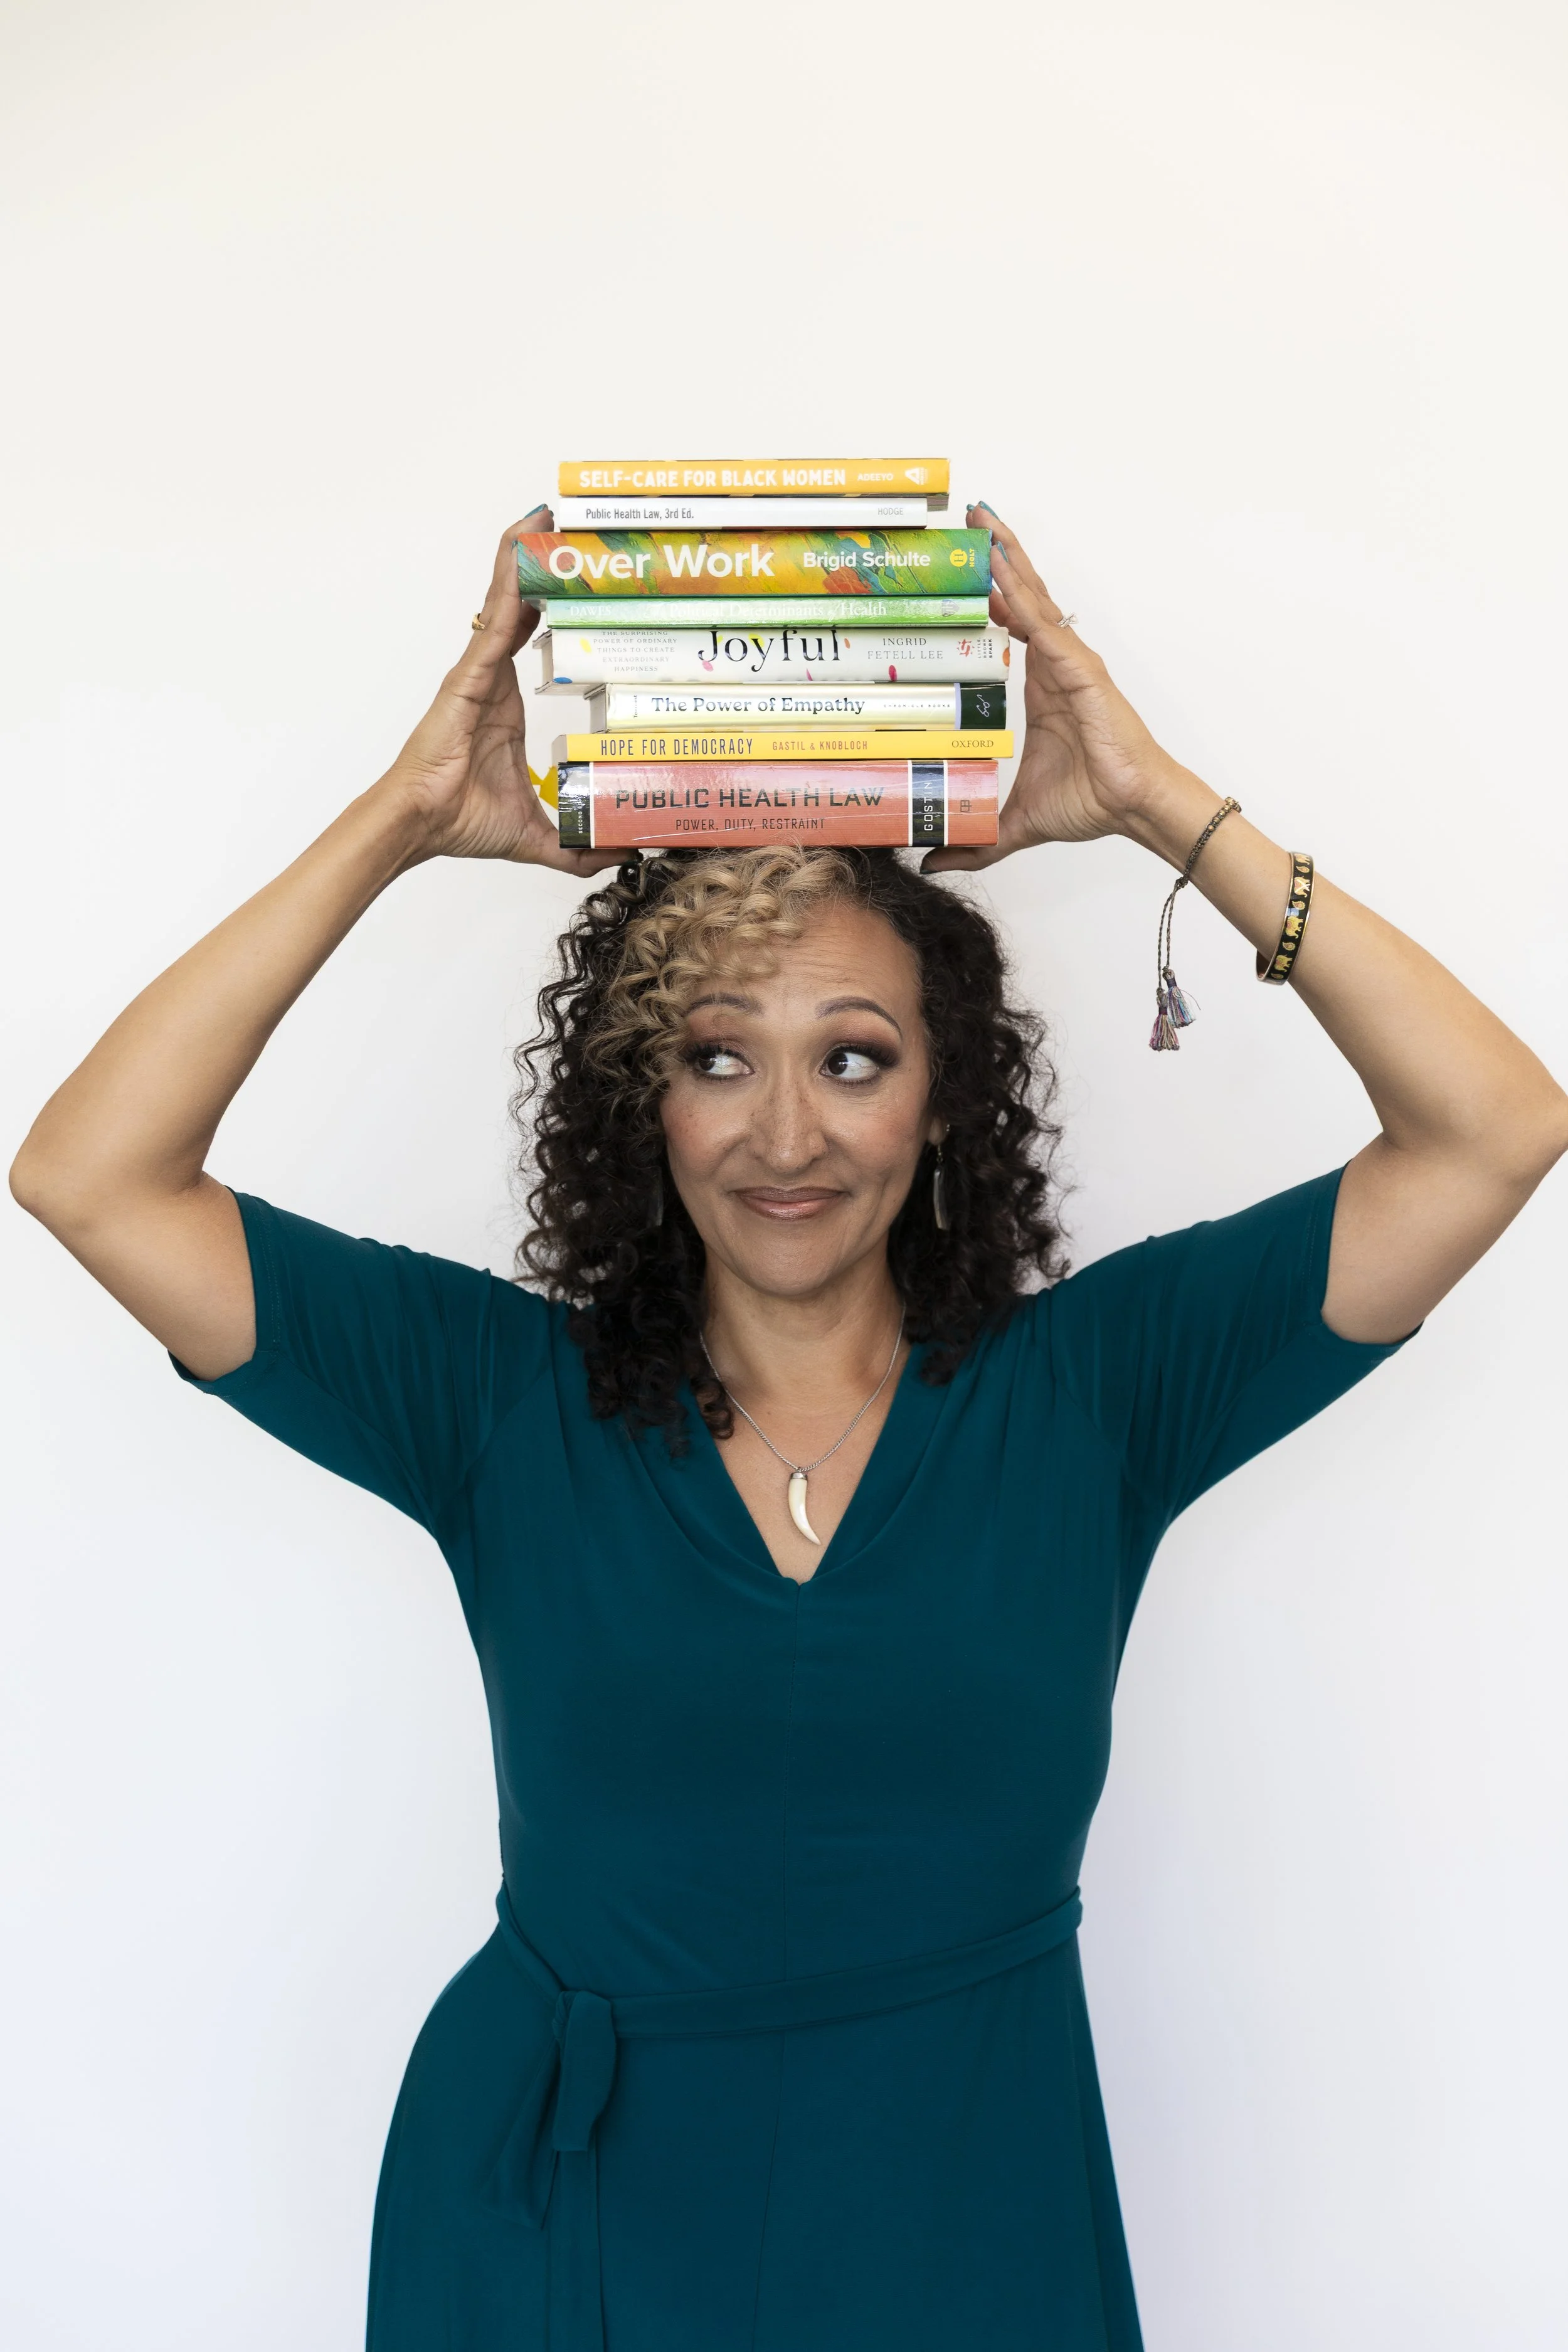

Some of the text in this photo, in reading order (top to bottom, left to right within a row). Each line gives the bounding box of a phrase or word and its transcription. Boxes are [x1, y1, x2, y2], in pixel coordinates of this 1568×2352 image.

[580, 469, 846, 487] SELF-CARE FOR BLACK WOMEN
[857, 472, 894, 482] ADEEYO
[586, 508, 694, 521] Public Health Law, 3rd Ed.
[878, 507, 904, 516] HODGE
[549, 544, 775, 580] Over Work
[803, 551, 931, 571] Brigid Schulte
[569, 605, 612, 617] DAWES
[840, 600, 887, 616] Health
[882, 638, 927, 646] INGRID
[697, 629, 841, 672] Joyful
[867, 650, 943, 659] FETELL LEE
[651, 697, 865, 715] The Power of Empathy
[601, 738, 753, 756] HOPE FOR DEMOCRACY
[772, 741, 806, 751] GASTIL
[819, 741, 868, 750] KNOBLOCH
[951, 740, 994, 748] OXFORD
[616, 786, 885, 809] PUBLIC HEALTH LAW
[924, 782, 933, 831] GOSTIN
[675, 817, 825, 831] POWER, DUTY, RESTRAINT
